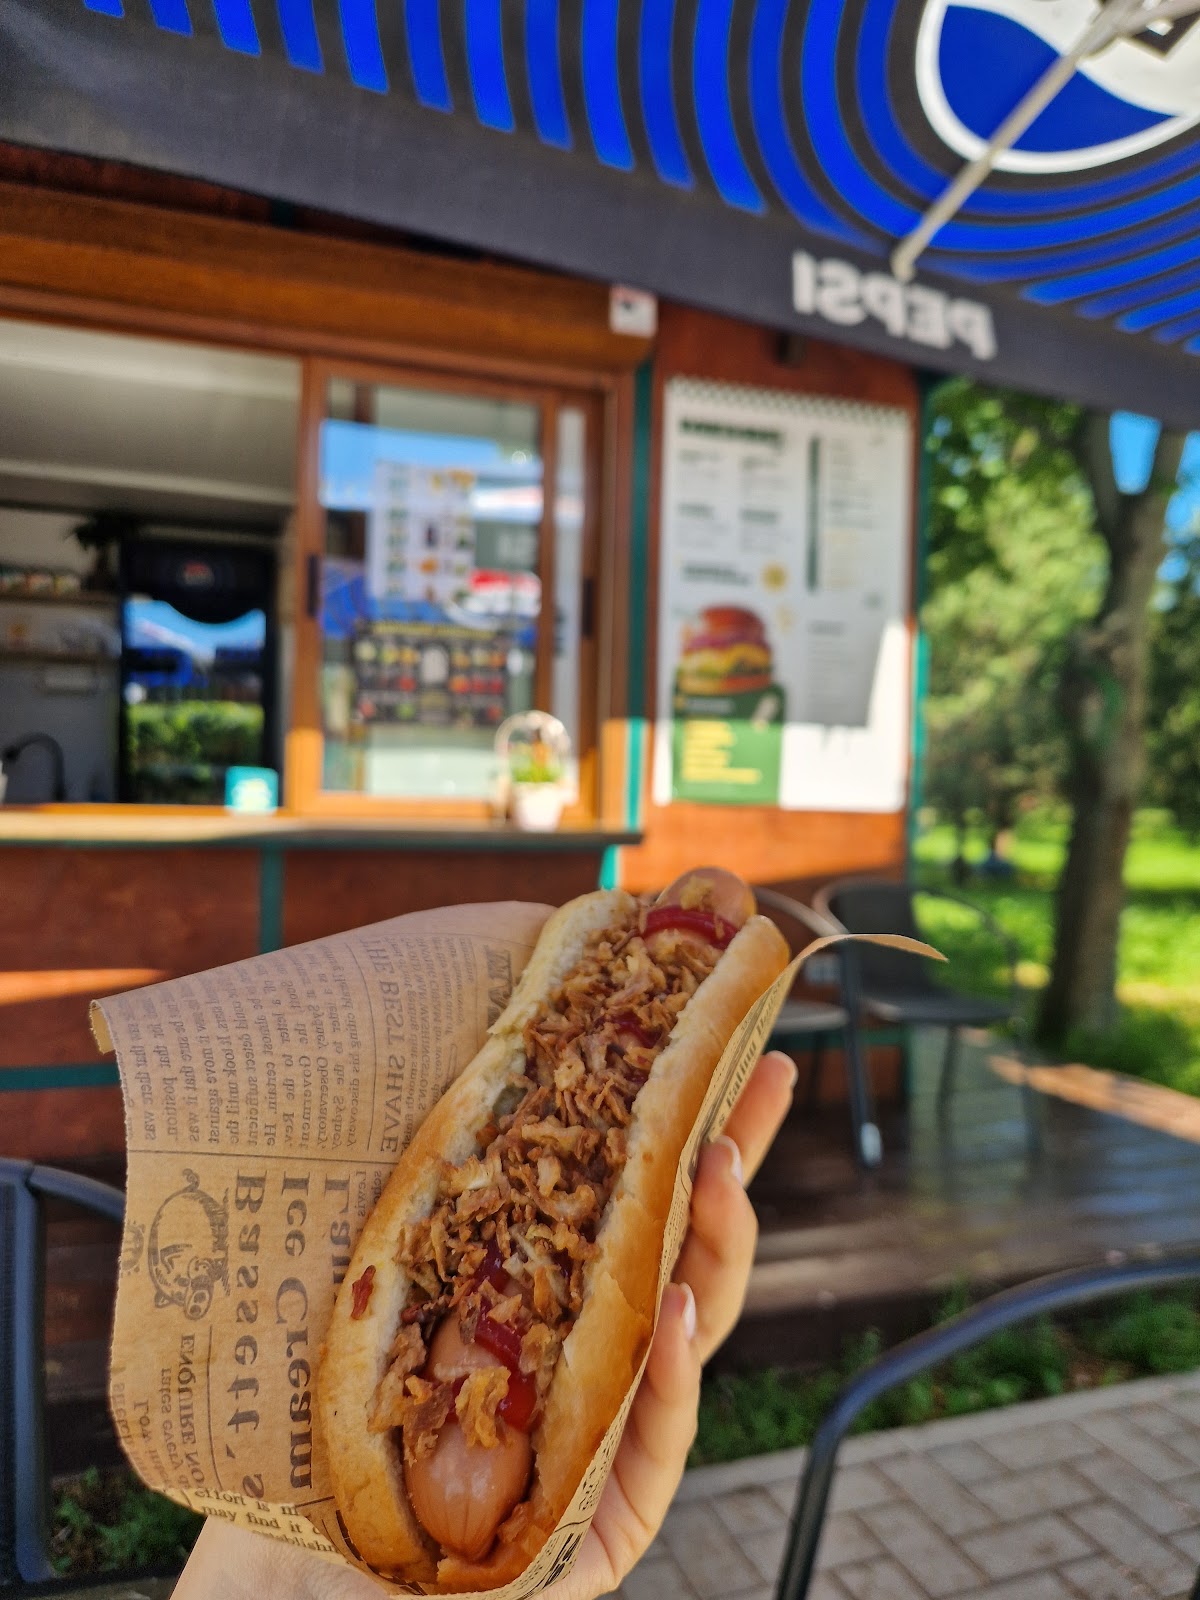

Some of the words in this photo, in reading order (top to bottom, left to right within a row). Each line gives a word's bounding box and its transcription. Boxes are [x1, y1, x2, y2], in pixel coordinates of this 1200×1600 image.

[256, 1499, 272, 1512] is
[200, 1505, 238, 1522] may
[246, 1511, 283, 1530] find
[289, 1518, 304, 1535] it
